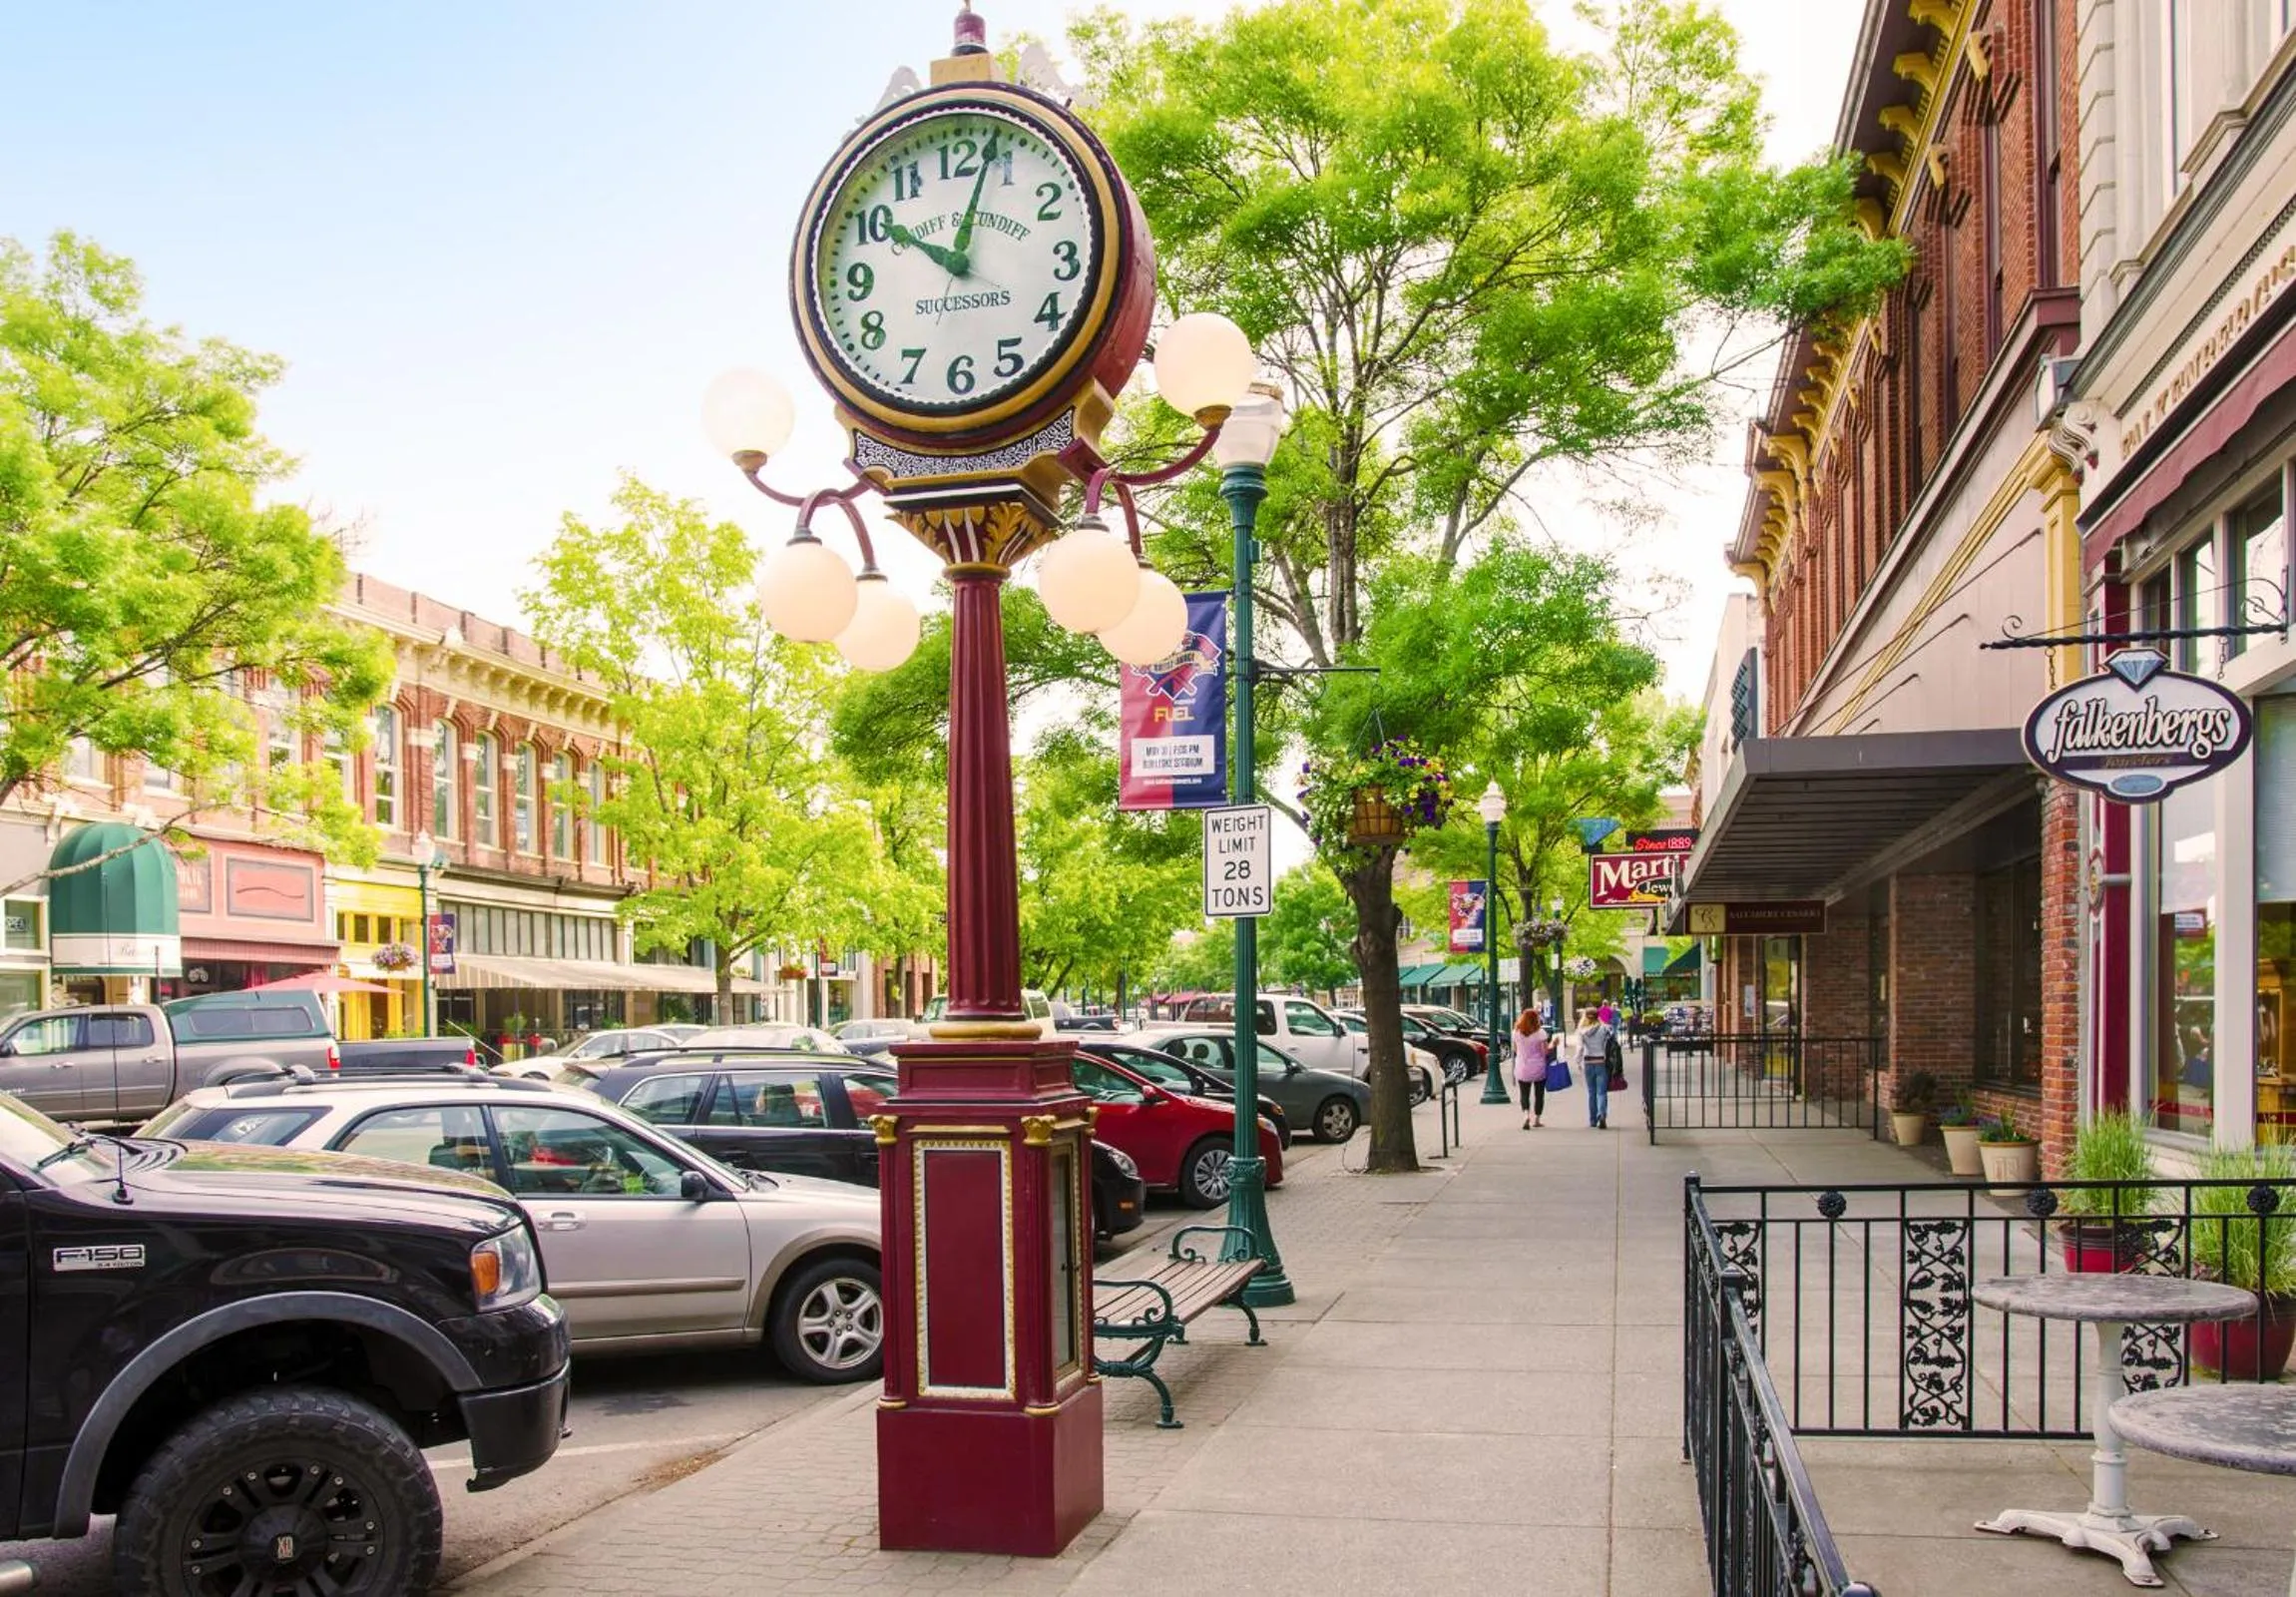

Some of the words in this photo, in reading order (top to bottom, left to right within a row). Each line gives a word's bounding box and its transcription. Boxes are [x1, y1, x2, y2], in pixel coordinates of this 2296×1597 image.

[937, 139, 979, 181] 12
[1001, 151, 1016, 187] 1
[890, 161, 922, 203] 11
[1036, 183, 1063, 222] 2
[855, 205, 894, 246] 10
[1053, 241, 1081, 280] 3
[847, 263, 874, 301] 9
[915, 289, 1012, 316] SUCCESSORS
[1034, 291, 1067, 331] 4
[861, 310, 886, 350] 8
[901, 347, 927, 384] 7
[947, 355, 976, 395] 6
[993, 337, 1025, 377] 5
[1154, 707, 1195, 723] FUEL
[2047, 696, 2231, 765] falkenbergs
[1211, 814, 1265, 833] WEIGHT
[1218, 836, 1256, 853] LIMIT
[1634, 837, 1667, 850] Since
[1223, 859, 1251, 880] 28
[1211, 886, 1264, 908] TONS
[56, 1247, 144, 1264] F-150
